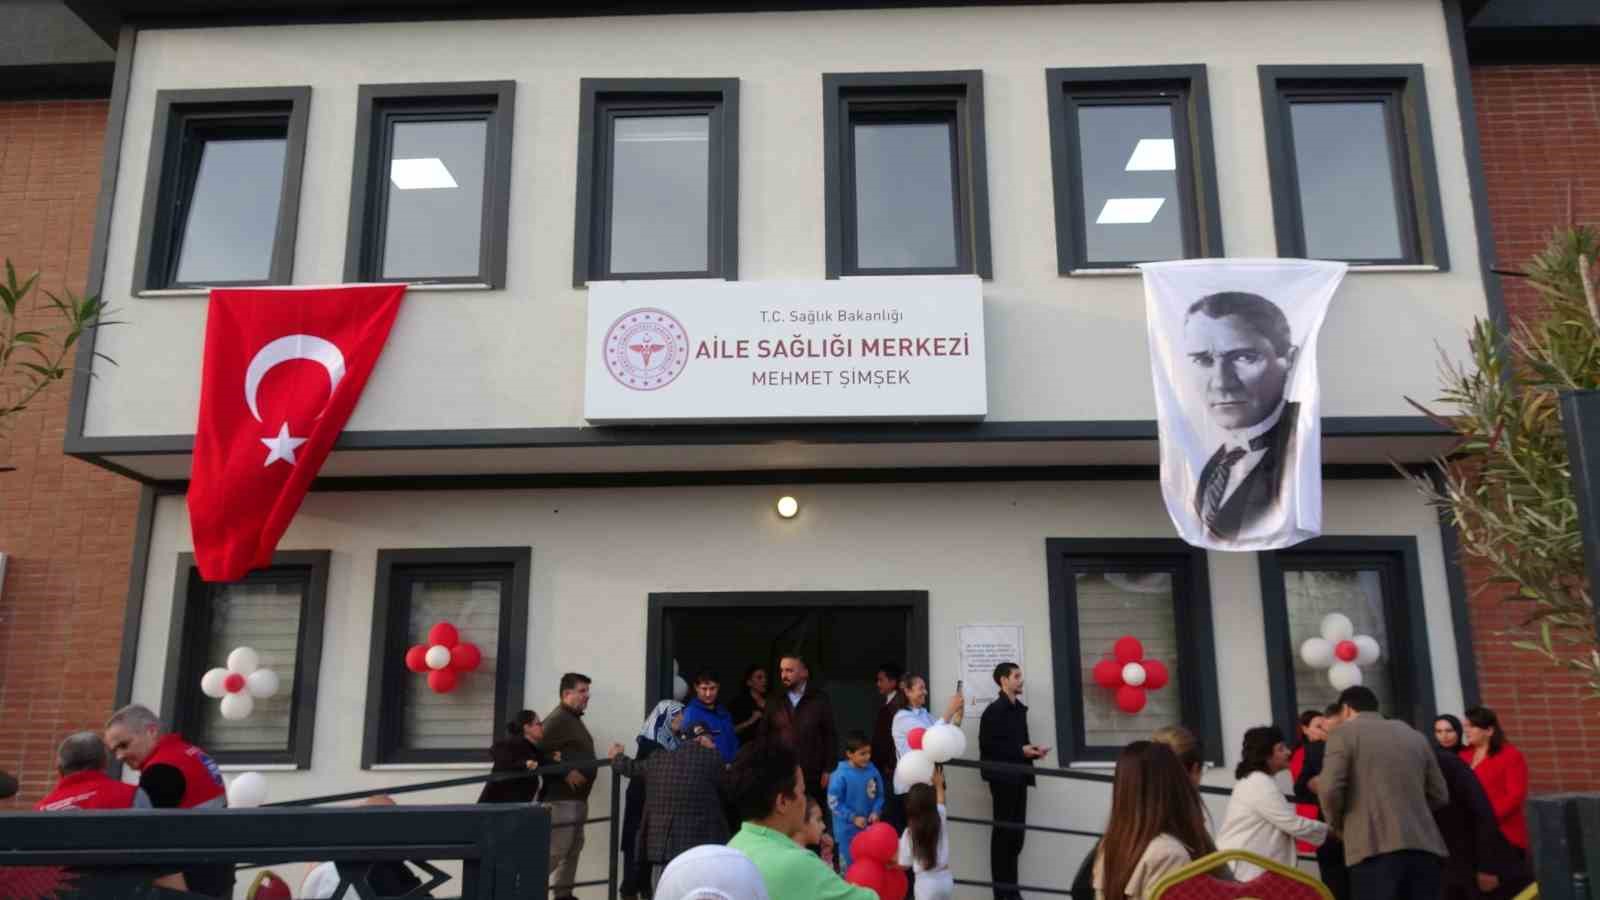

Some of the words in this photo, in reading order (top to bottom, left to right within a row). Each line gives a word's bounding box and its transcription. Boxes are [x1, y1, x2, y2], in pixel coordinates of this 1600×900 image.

[759, 310, 786, 324] T.C.
[789, 309, 833, 325] Sağlık
[837, 309, 903, 325] Bakanlığı
[695, 336, 750, 360] AİLE
[757, 332, 853, 359] SAĞLIĞI
[860, 331, 970, 358] MERKEZİ
[751, 370, 833, 386] MEHMET
[838, 367, 911, 389] ŞİMŞEK
